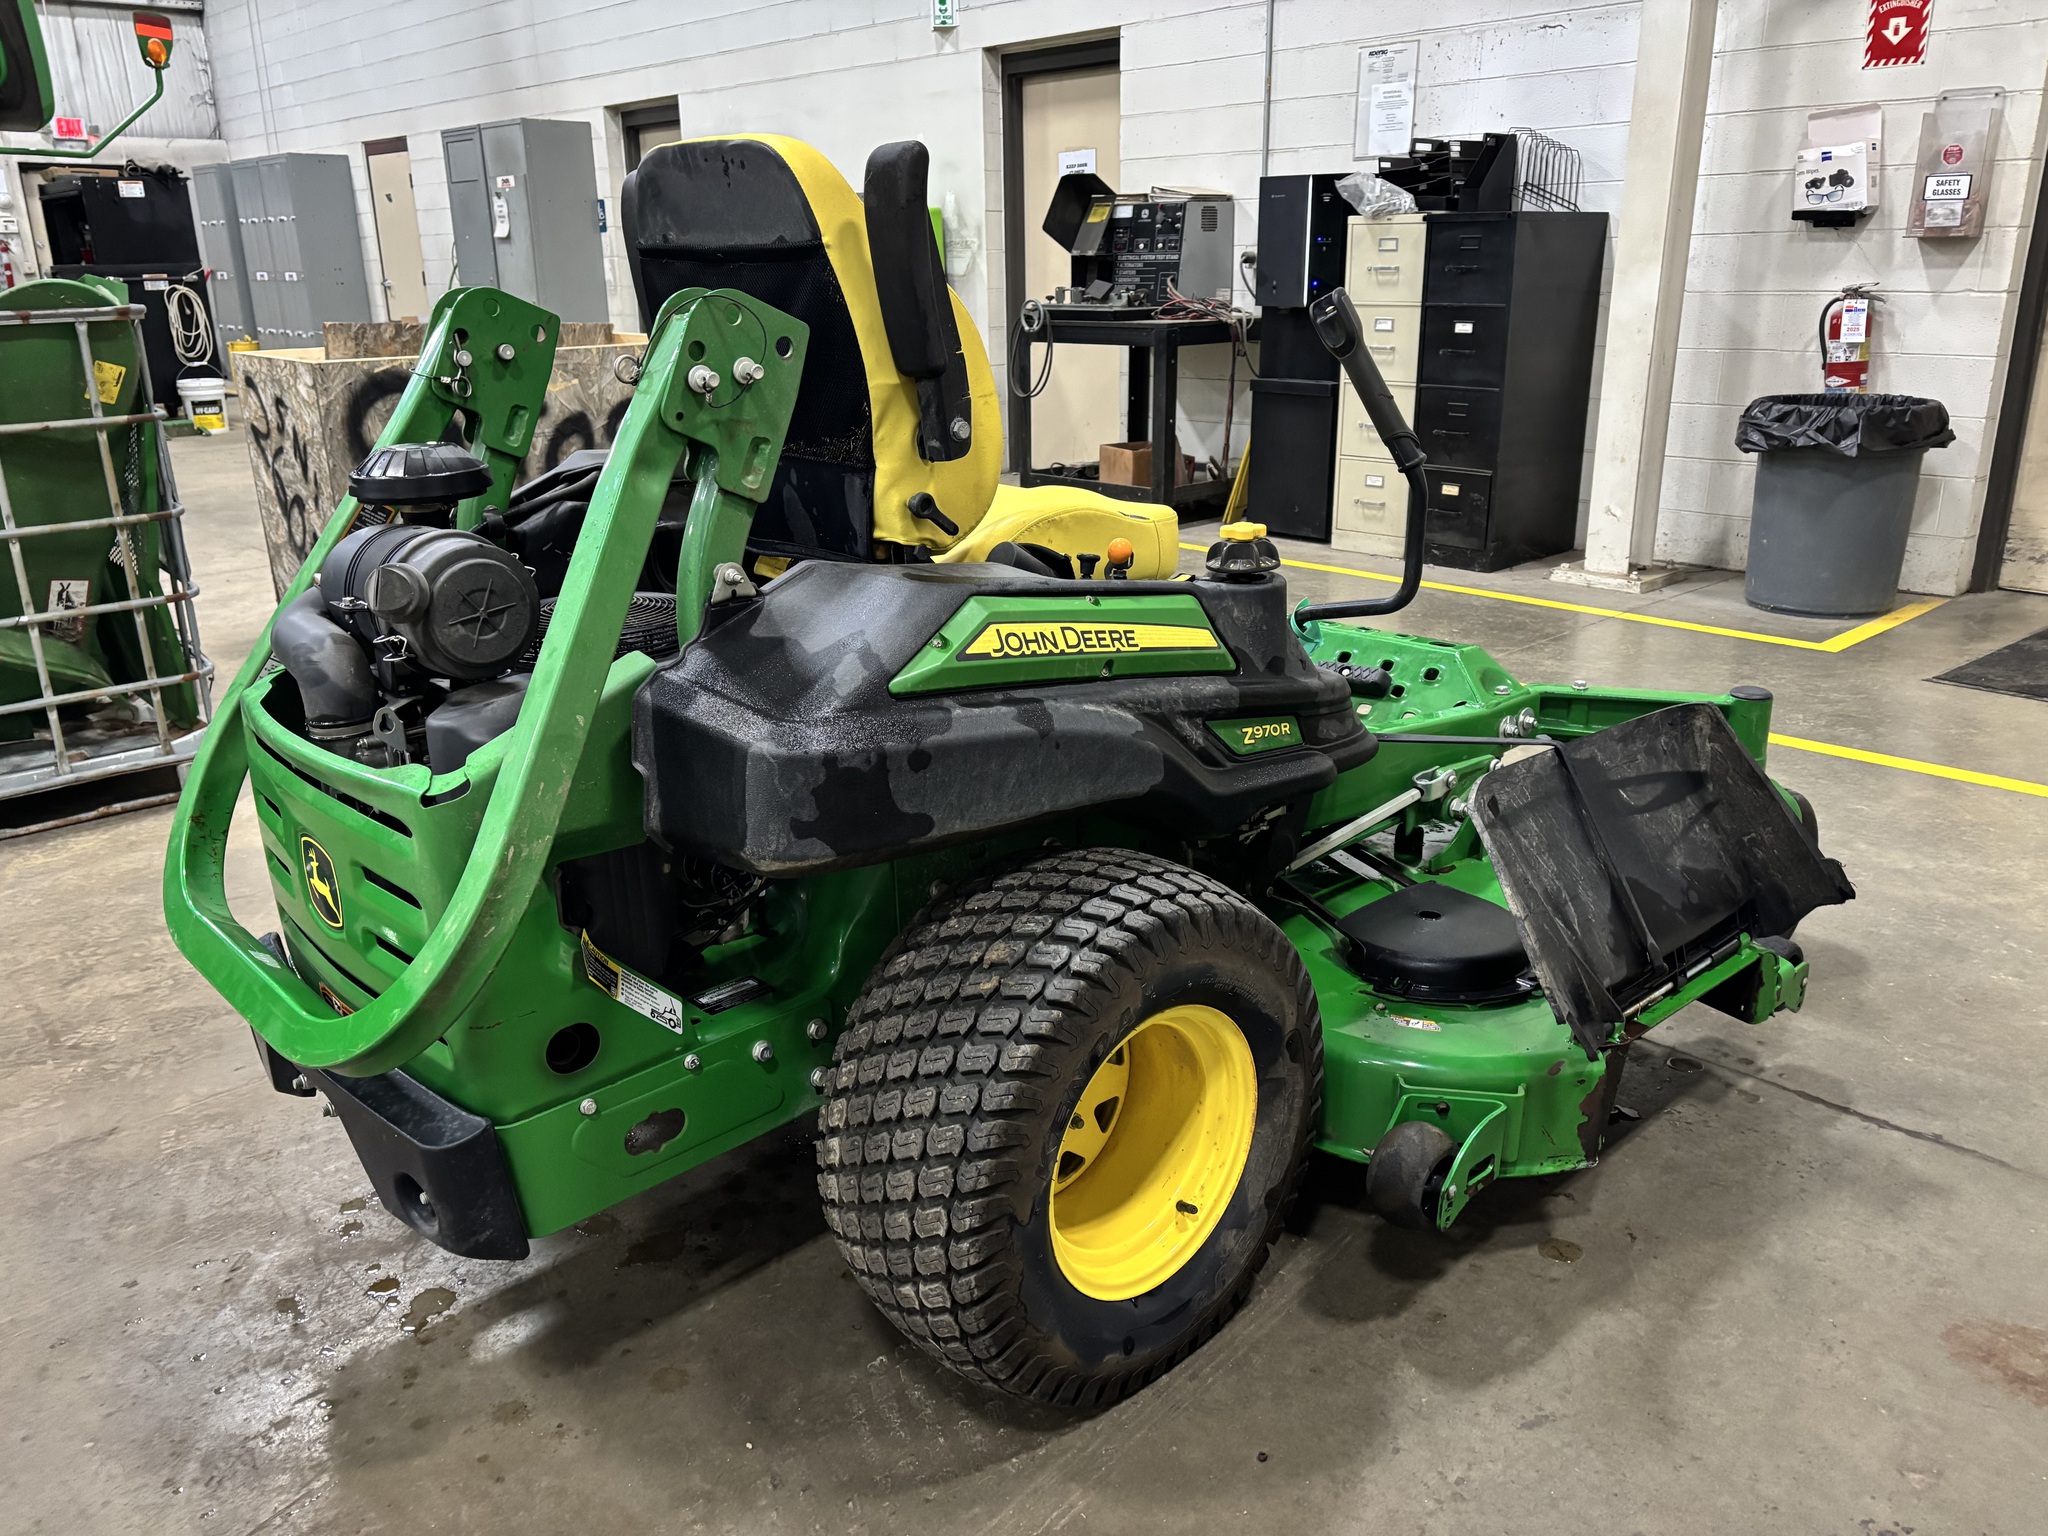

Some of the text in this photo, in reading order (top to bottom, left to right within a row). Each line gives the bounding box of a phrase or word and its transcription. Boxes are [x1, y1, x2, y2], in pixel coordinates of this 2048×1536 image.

[1936, 179, 1961, 187] SAFETY
[1932, 188, 1961, 196] GLASSES
[992, 626, 1139, 653] JOHN DEERE
[1242, 722, 1291, 744] Z970R
